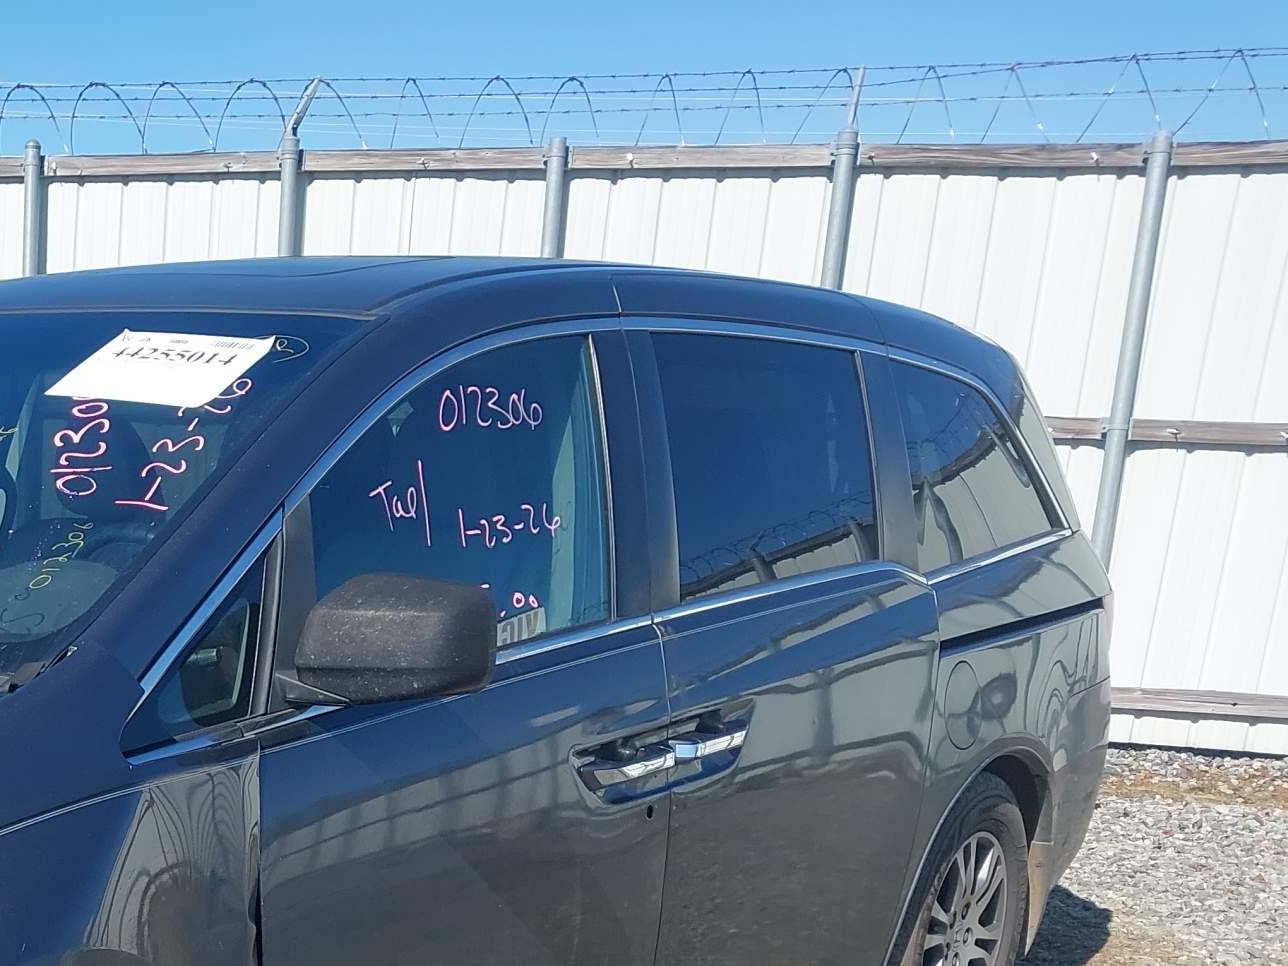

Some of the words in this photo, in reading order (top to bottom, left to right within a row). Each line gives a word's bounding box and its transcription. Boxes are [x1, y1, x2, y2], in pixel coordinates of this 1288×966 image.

[111, 345, 239, 366] 44255014
[439, 384, 544, 431] 012306
[50, 395, 112, 495] 01230
